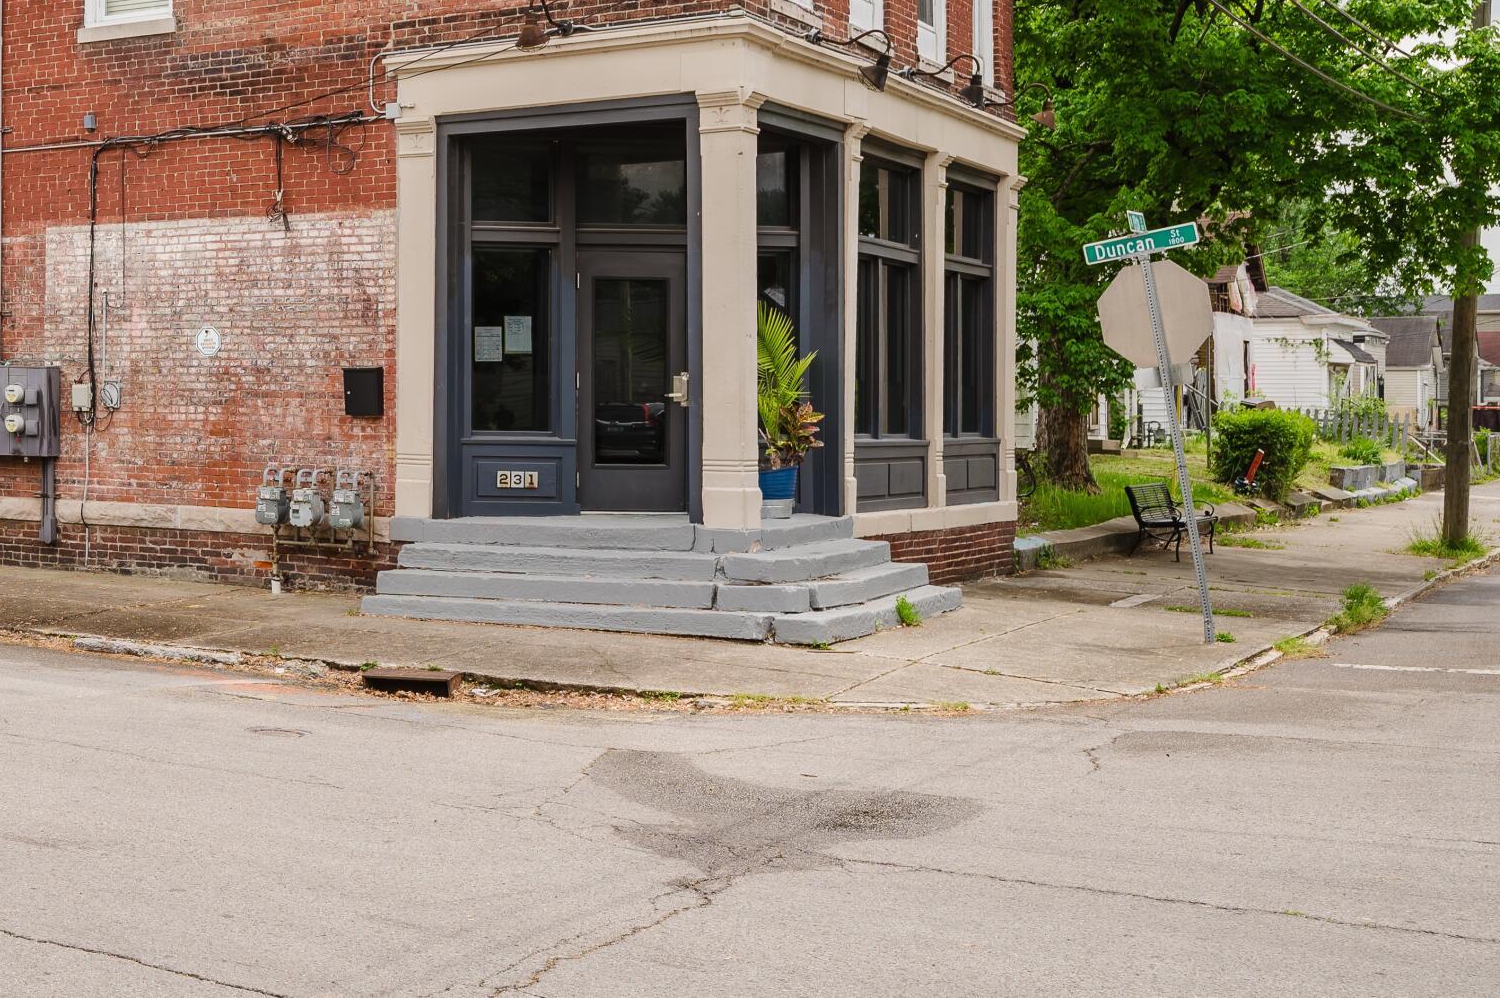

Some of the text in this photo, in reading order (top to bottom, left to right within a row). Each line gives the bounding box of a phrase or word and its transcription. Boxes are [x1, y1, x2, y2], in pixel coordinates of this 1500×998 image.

[1170, 228, 1181, 238] St
[1168, 236, 1185, 246] 1800
[1095, 237, 1155, 260] Duncan
[499, 473, 535, 485] 231
